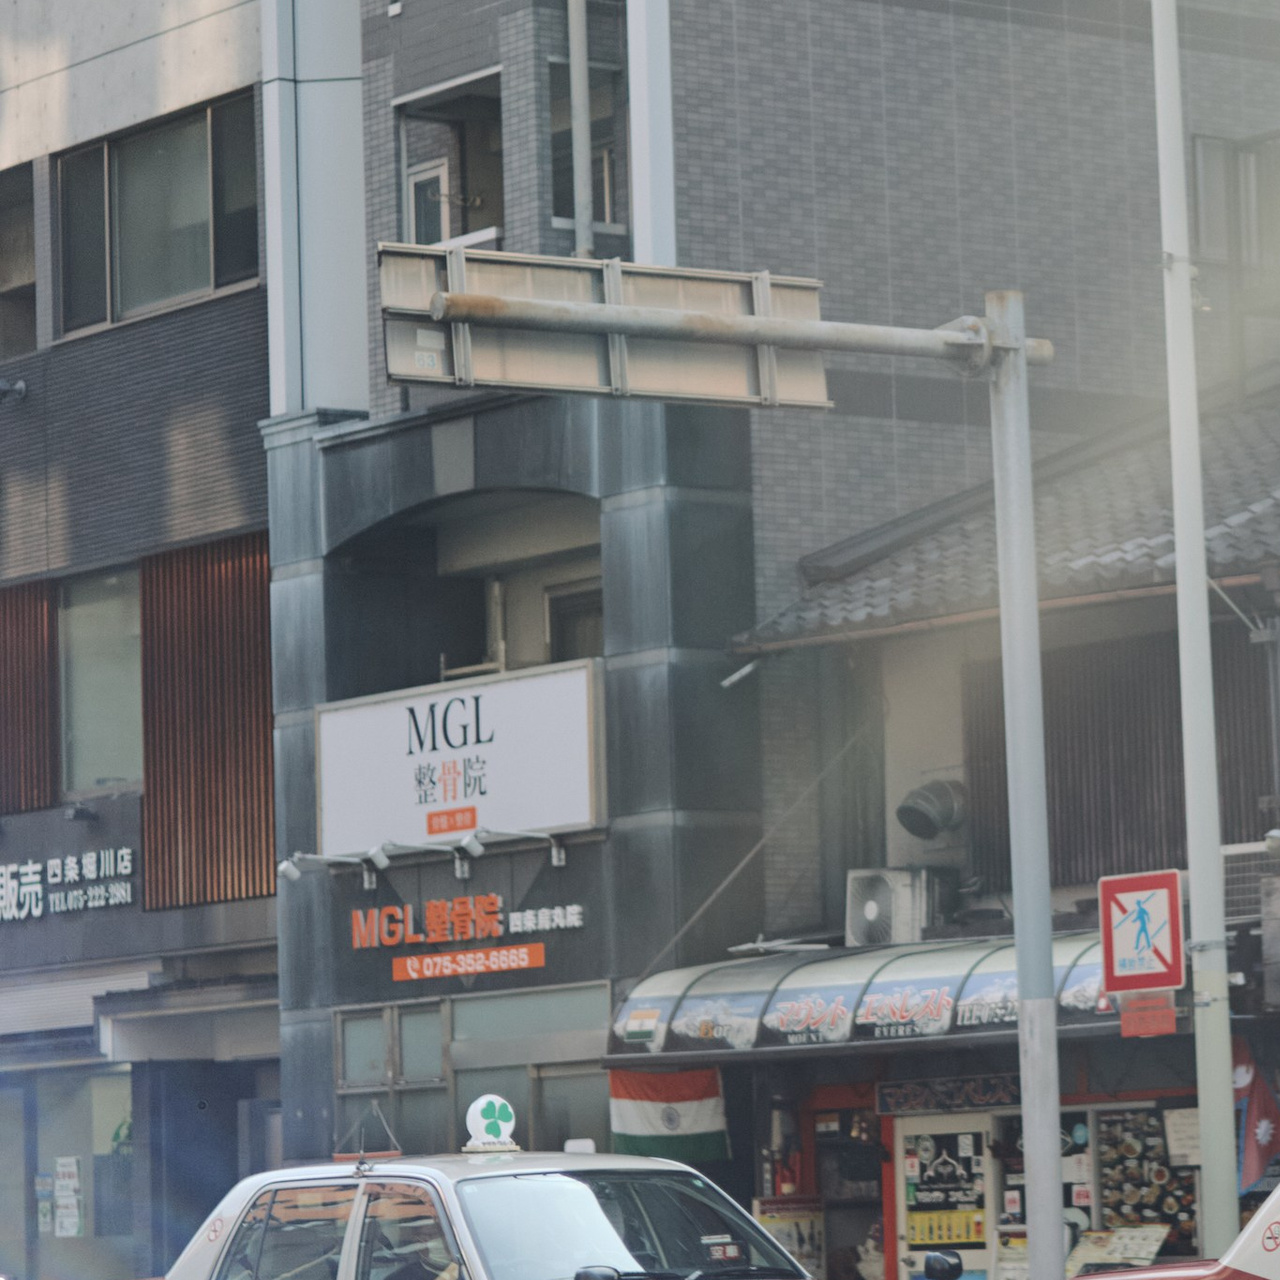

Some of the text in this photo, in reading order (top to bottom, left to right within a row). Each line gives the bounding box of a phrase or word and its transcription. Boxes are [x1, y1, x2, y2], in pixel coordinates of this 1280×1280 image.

[405, 694, 495, 756] MGL
[414, 754, 487, 806] 整骨院
[47, 846, 133, 885] 四条堀川店
[352, 904, 425, 950] MGL
[424, 892, 504, 944] 整骨院
[422, 947, 530, 977] 075-352-6665
[776, 986, 954, 1032] マウント エベレスト
